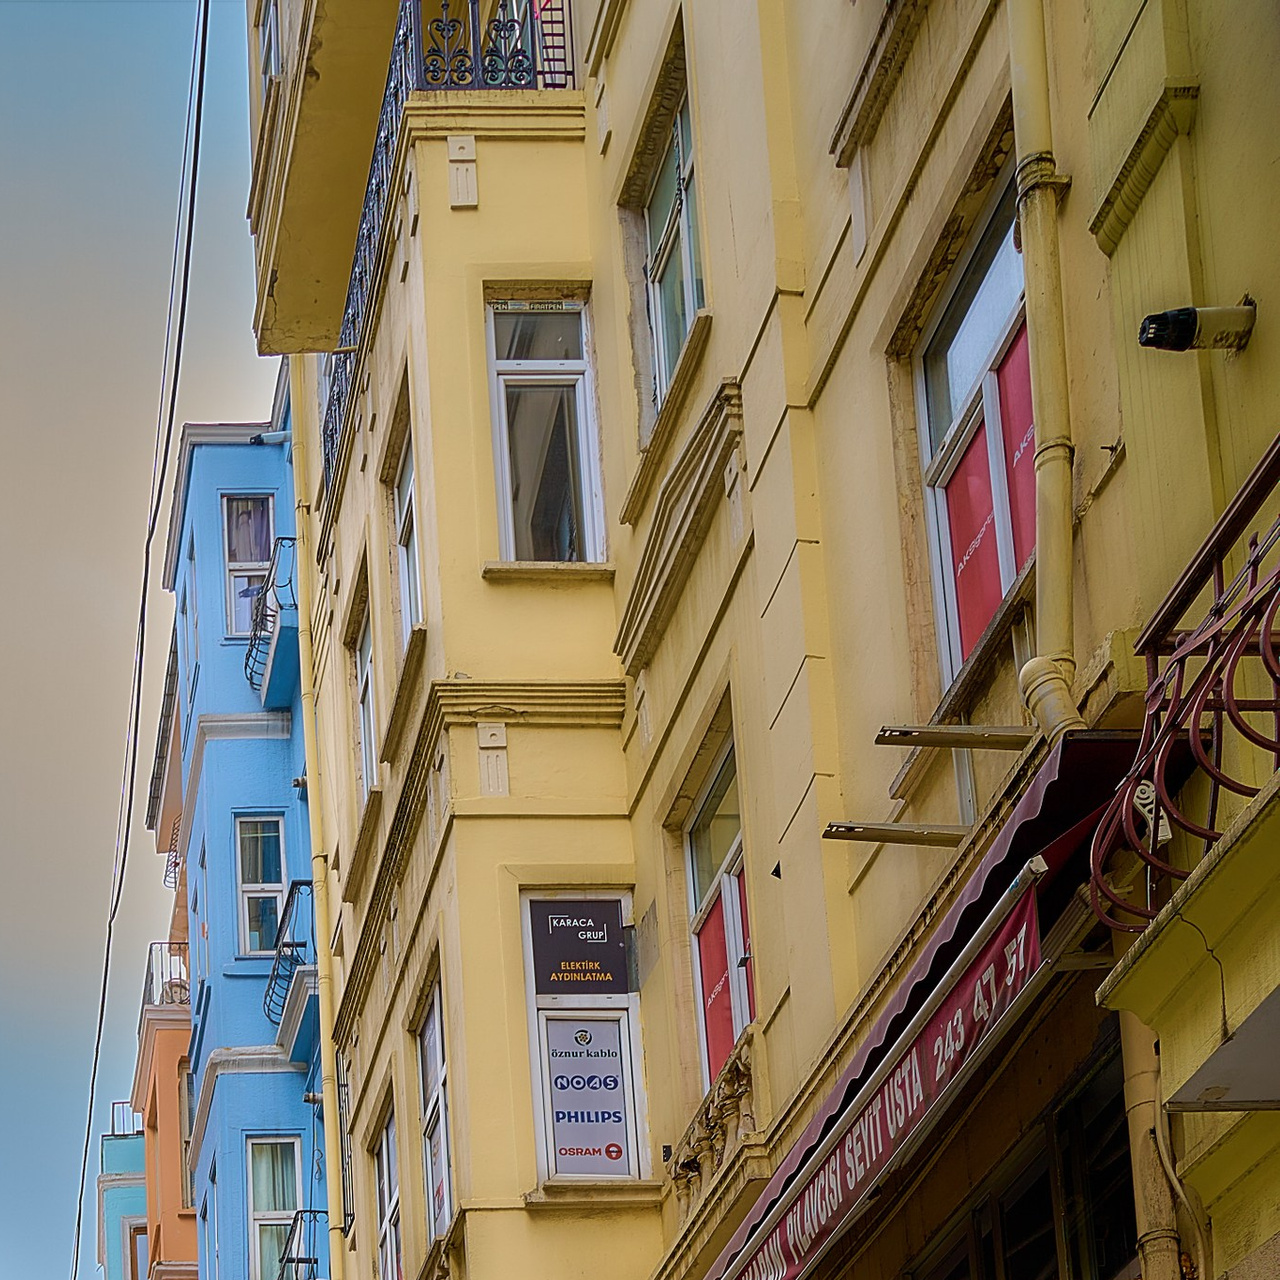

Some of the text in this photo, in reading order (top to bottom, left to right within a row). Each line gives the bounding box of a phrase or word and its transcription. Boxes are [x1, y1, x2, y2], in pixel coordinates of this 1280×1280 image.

[552, 919, 594, 927] KARACA
[578, 931, 604, 939] GRUP
[561, 960, 601, 970] ELEKTİRK
[550, 972, 613, 981] AYDINLATMA
[551, 1049, 618, 1058] öznur kablo
[554, 1075, 619, 1091] NOAS
[786, 1149, 843, 1266] PİLAVCISI
[844, 1100, 884, 1191] SEYİT
[883, 1046, 924, 1140] USTA
[933, 1008, 965, 1082] 243
[972, 962, 998, 1023] 47
[1004, 921, 1027, 987] 57
[555, 1111, 622, 1123] PHILIPS
[558, 1147, 602, 1156] OSRAM
